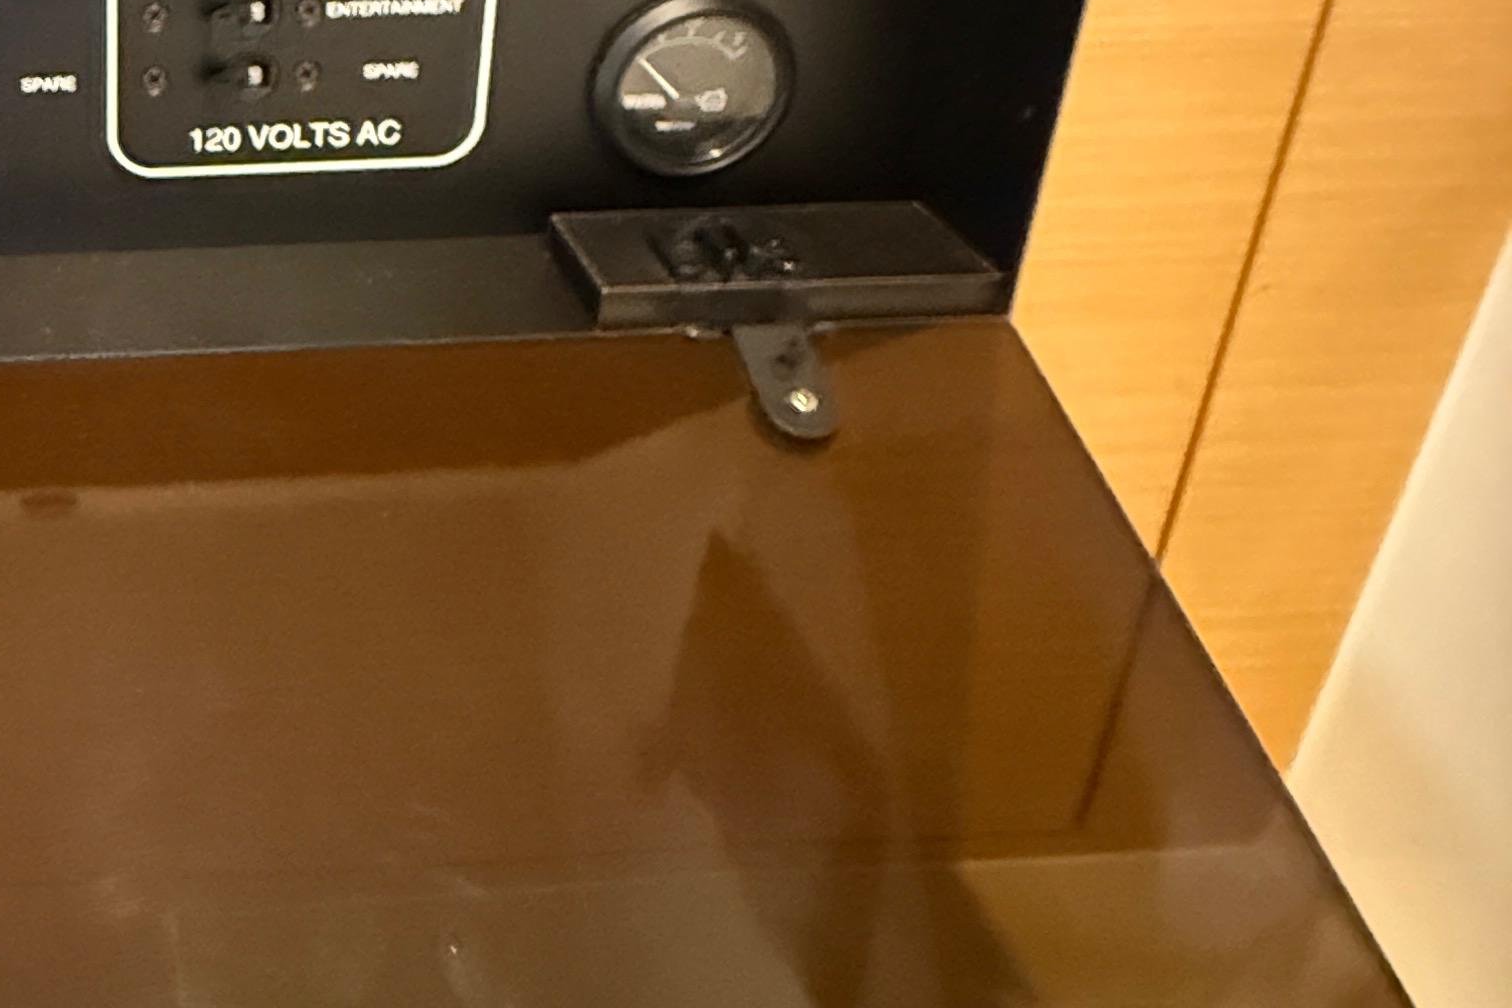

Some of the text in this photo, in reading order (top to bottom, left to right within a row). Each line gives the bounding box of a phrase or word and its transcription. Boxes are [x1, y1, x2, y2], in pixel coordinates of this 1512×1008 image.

[362, 61, 419, 80] SPARE
[20, 74, 77, 94] SPARE
[189, 118, 402, 153] 120 VOLTS AC
